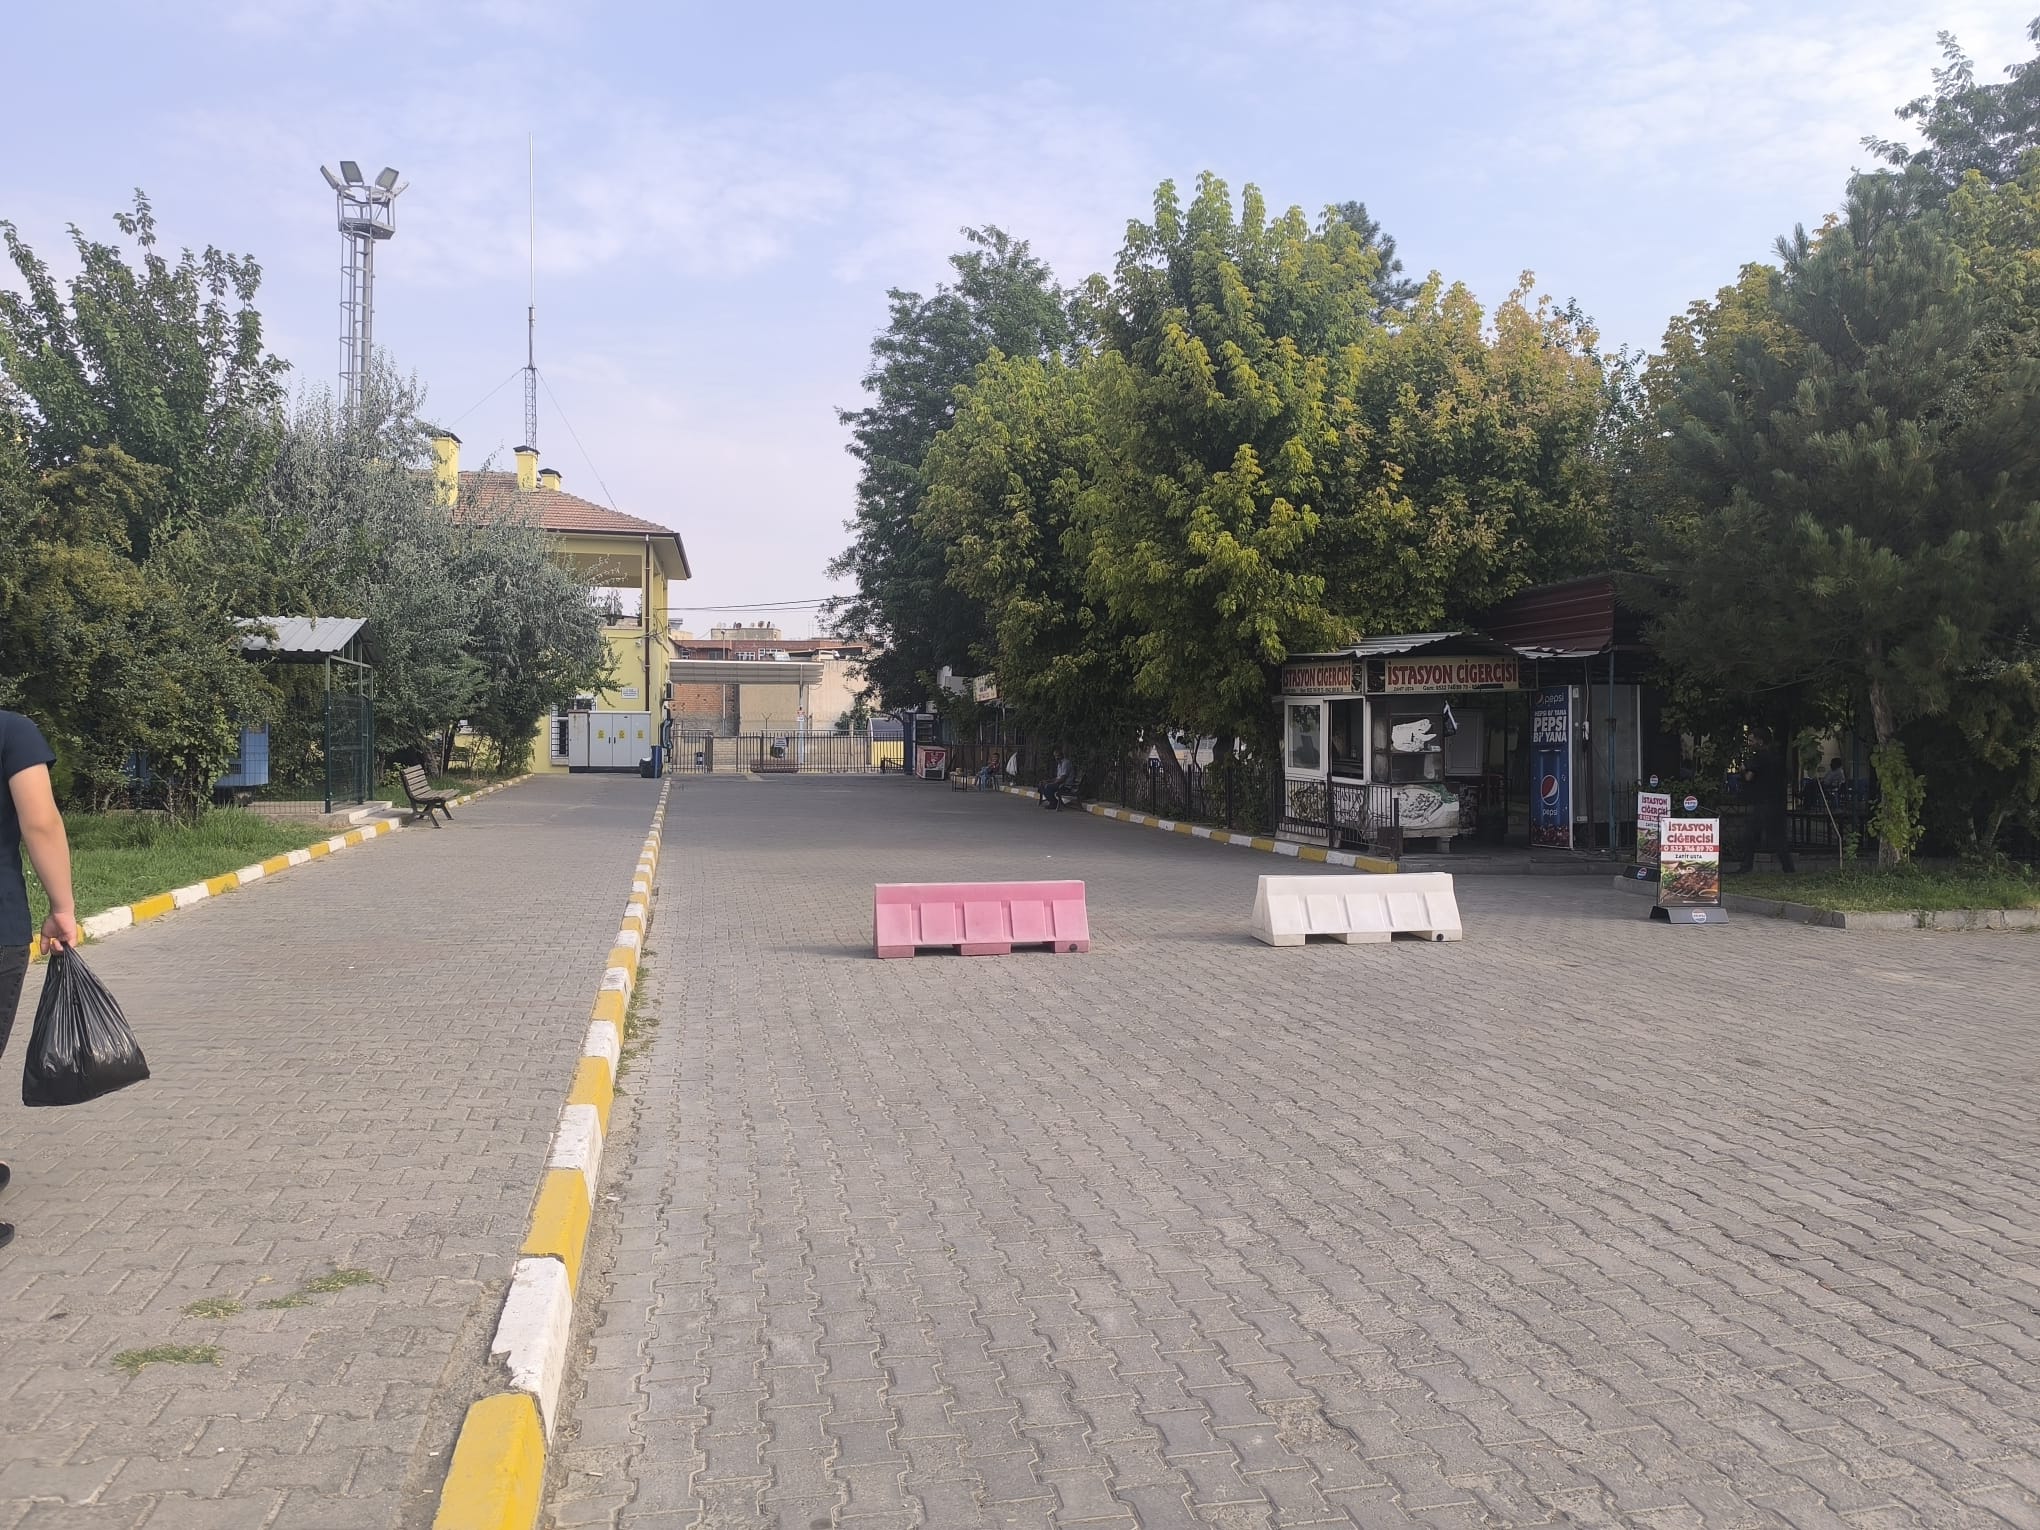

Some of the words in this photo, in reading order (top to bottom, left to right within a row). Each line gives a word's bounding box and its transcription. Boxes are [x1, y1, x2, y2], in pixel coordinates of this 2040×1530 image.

[1387, 660, 1453, 685] İSTASYON
[1544, 692, 1564, 704] pepsi
[1545, 731, 1567, 743] YANA
[1542, 808, 1558, 818] pepsi
[1668, 822, 1713, 832] İSTASYON
[1667, 833, 1714, 844] CİĞERCİSİ
